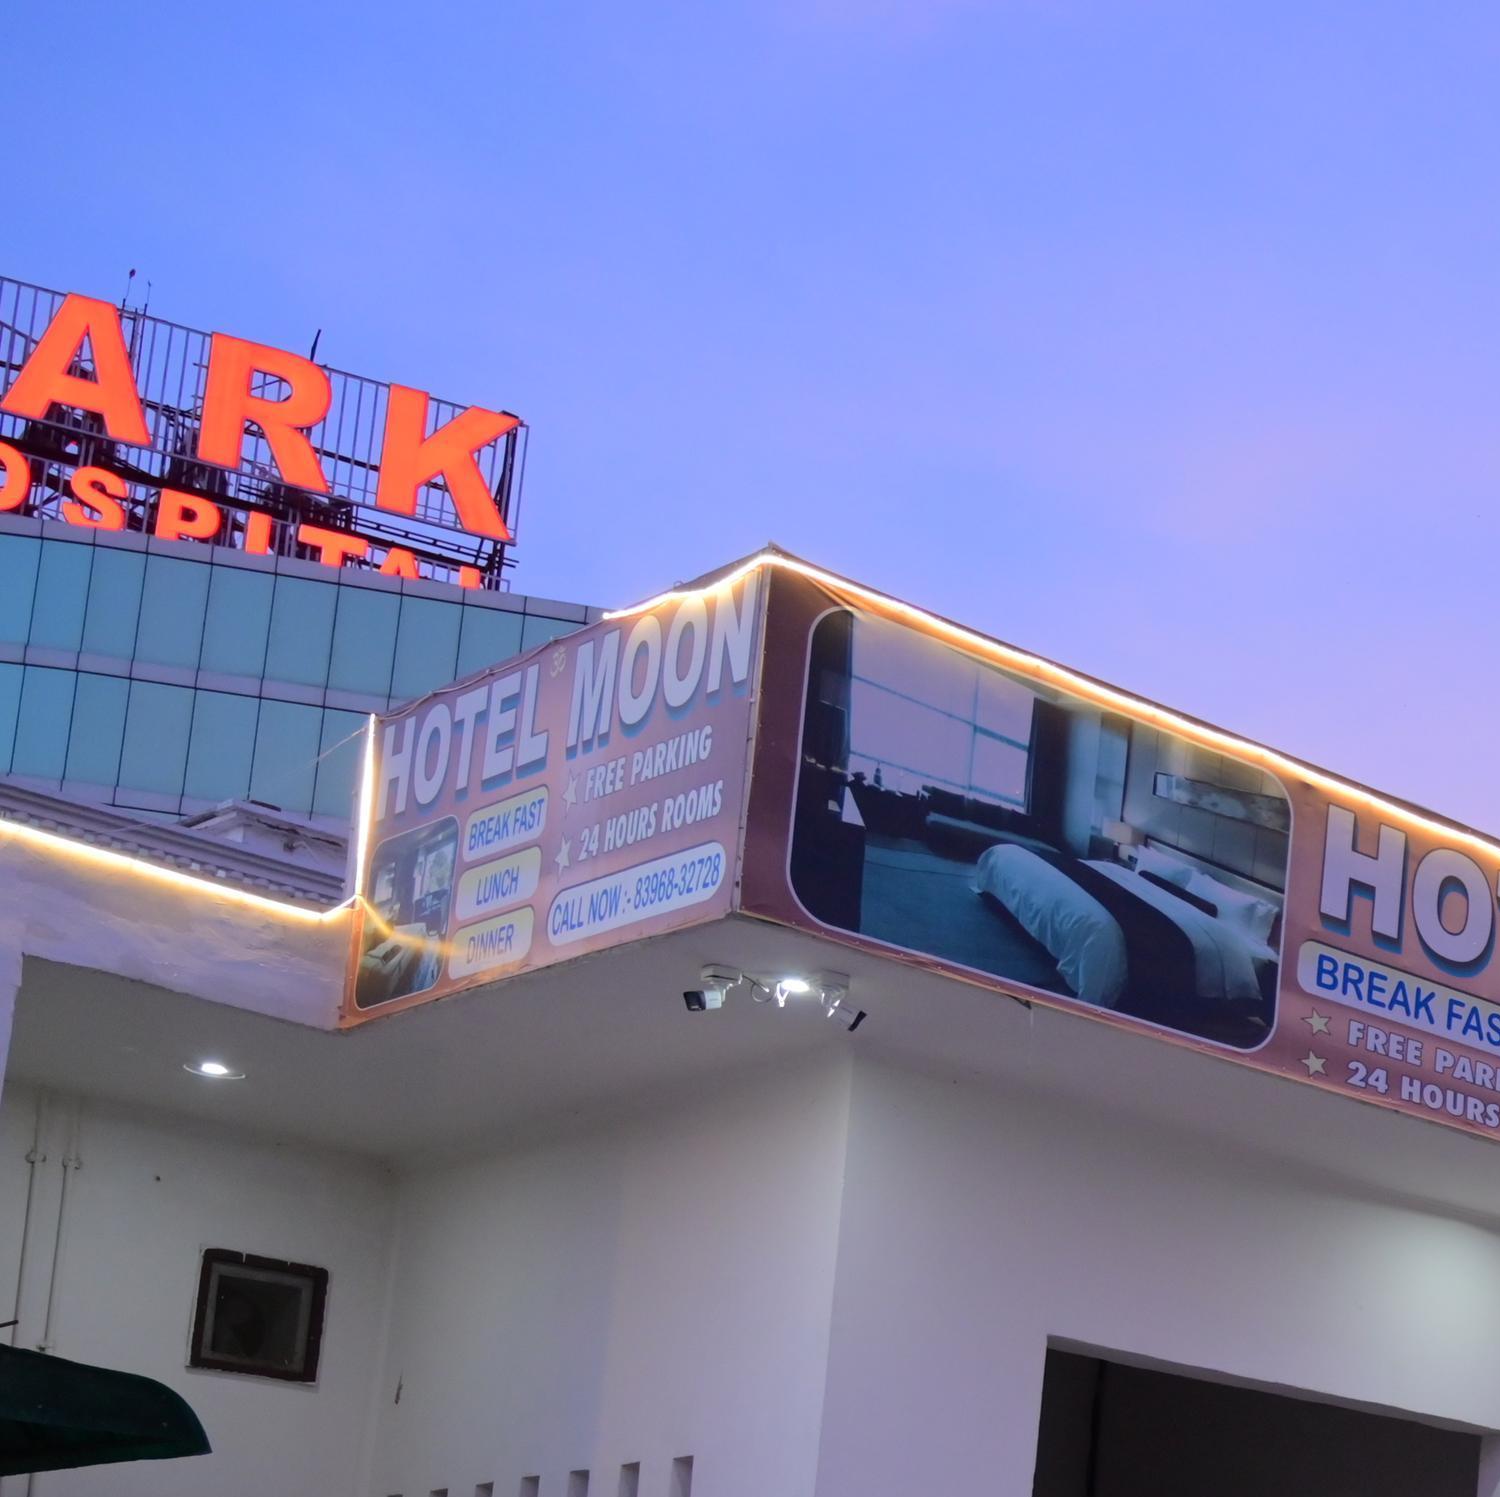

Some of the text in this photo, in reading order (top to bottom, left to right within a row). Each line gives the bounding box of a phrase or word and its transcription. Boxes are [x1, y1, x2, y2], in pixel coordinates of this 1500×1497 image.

[0, 292, 521, 541] ARK
[376, 570, 757, 822] HOTEL MOON
[583, 725, 713, 803] FREE PARKING
[468, 798, 545, 852] BREAK FAST
[577, 779, 724, 863] 24 HOURS ROOMS
[475, 865, 520, 906] LUNCH
[552, 896, 584, 936] CALL
[587, 883, 622, 925] NOW
[633, 852, 722, 909] 83968-32728
[466, 923, 515, 964] DINNER
[1315, 953, 1436, 1025] BREAK
[1347, 1020, 1424, 1067] FREE
[1346, 1060, 1389, 1095] 24
[1400, 1075, 1500, 1128] HOURS
